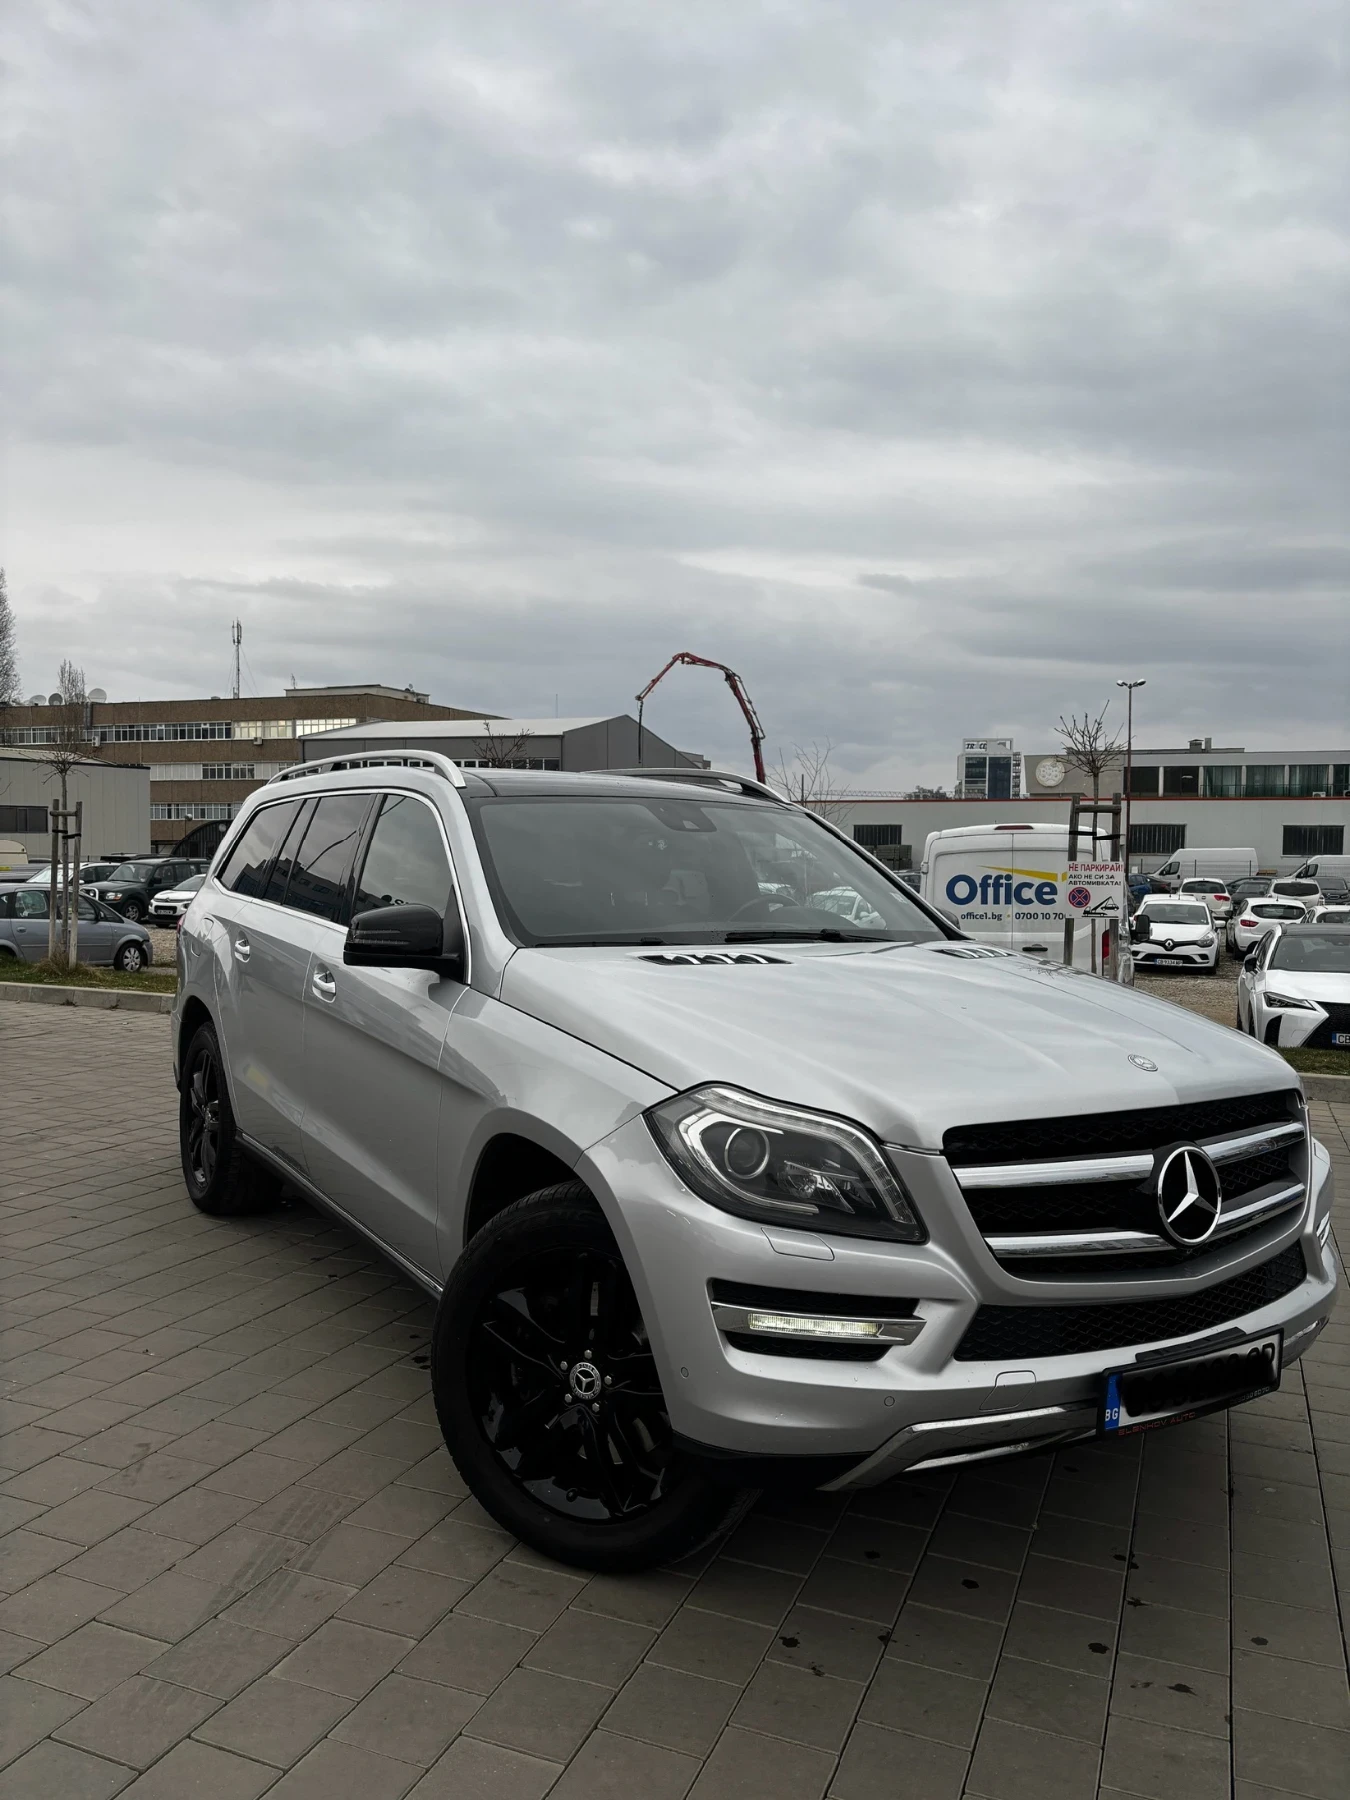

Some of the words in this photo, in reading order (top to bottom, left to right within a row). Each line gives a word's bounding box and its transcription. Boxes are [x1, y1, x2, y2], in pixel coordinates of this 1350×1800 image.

[1068, 863, 1079, 872] НЕ
[1080, 862, 1123, 872] ПАРКИРАЙ!
[945, 873, 1058, 906] Office
[960, 911, 1003, 921] office1.bg
[1014, 912, 1039, 920] 0700
[1041, 912, 1051, 920] 10
[1105, 1408, 1119, 1421] BG
[1170, 1412, 1196, 1425] AUTO
